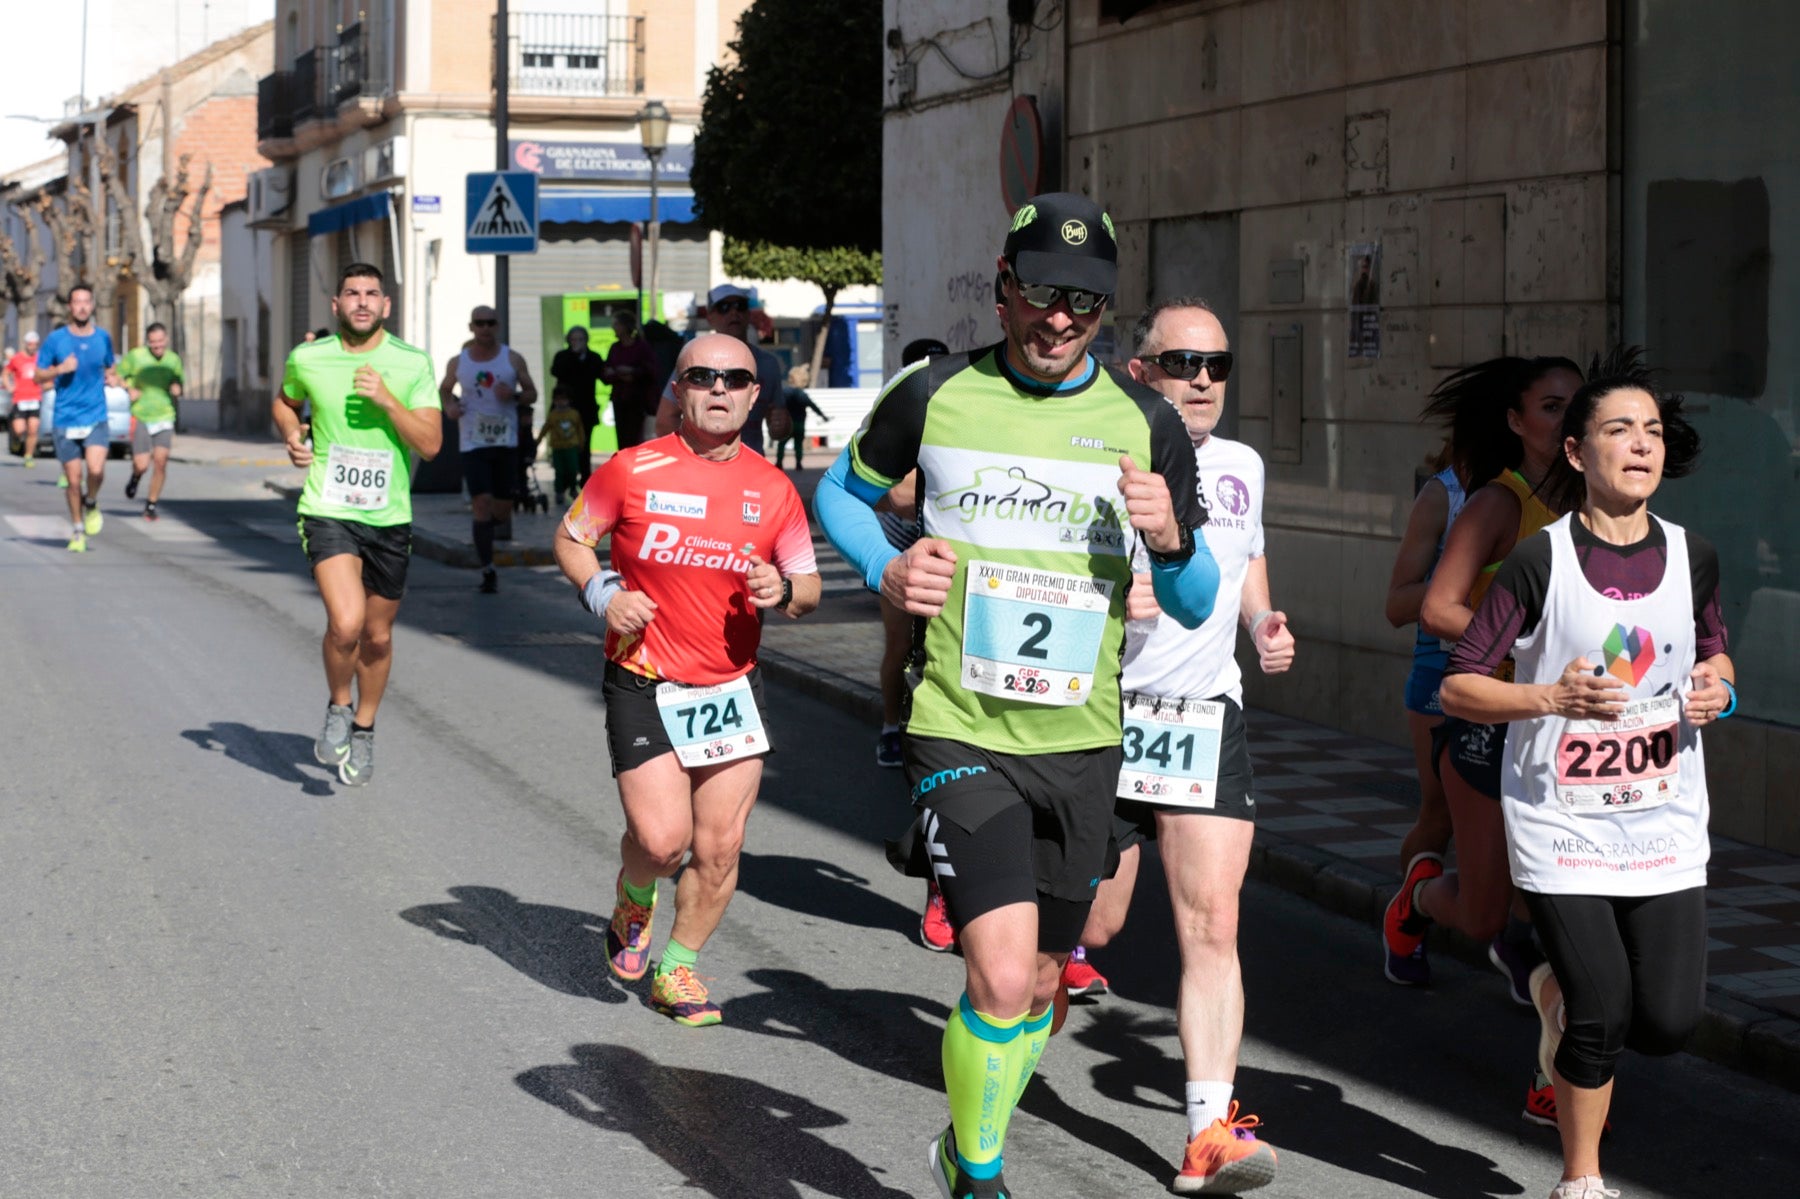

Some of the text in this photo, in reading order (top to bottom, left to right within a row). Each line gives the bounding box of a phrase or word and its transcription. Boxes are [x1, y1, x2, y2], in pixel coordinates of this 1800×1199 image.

[1065, 224, 1085, 240] Buff
[1070, 436, 1104, 450] FMB
[334, 464, 387, 488] 3086
[1206, 517, 1246, 530] ANTA FE
[638, 522, 753, 574] Polisalu
[685, 536, 732, 551] Clínicas
[979, 565, 1106, 595] XXXIII GRAN PREMIO DE FONDO
[1016, 612, 1053, 660] 2
[676, 697, 744, 739] 724
[1192, 703, 1217, 716] FONDO
[1122, 725, 1195, 771] 341
[1565, 729, 1673, 778] 2200
